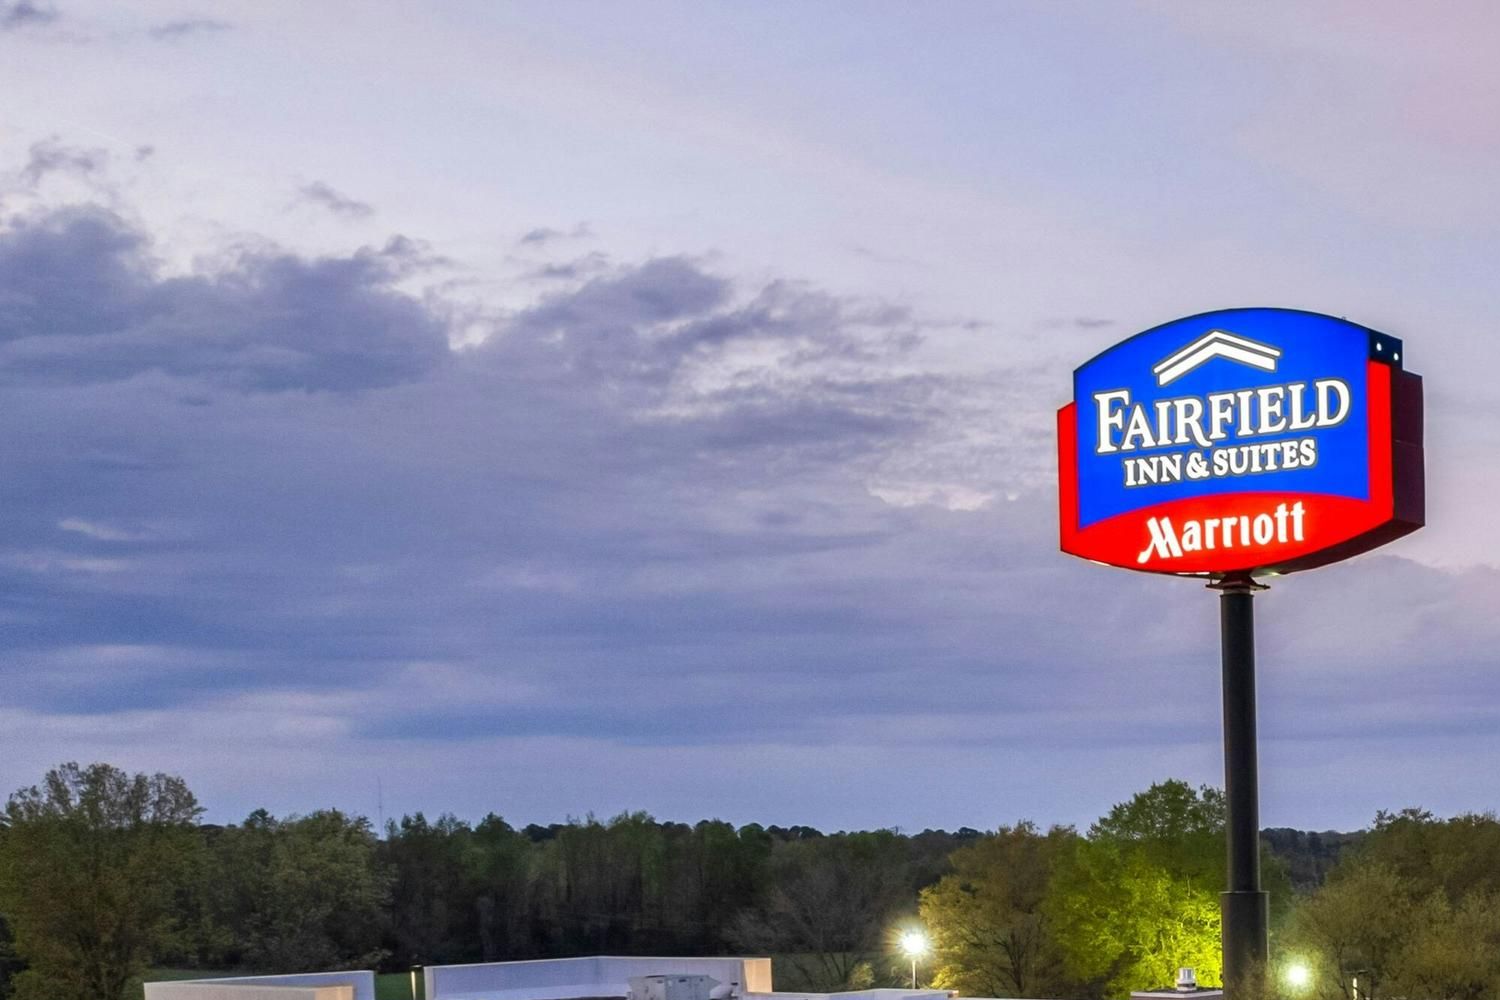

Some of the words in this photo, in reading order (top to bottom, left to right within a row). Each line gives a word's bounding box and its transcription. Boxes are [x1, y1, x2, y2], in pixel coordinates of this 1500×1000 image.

[1094, 380, 1351, 454] FAIRFIELD
[1124, 454, 1181, 487] INN
[1186, 453, 1210, 478] &
[1212, 438, 1317, 475] SUITES
[1137, 501, 1306, 564] Marriott
